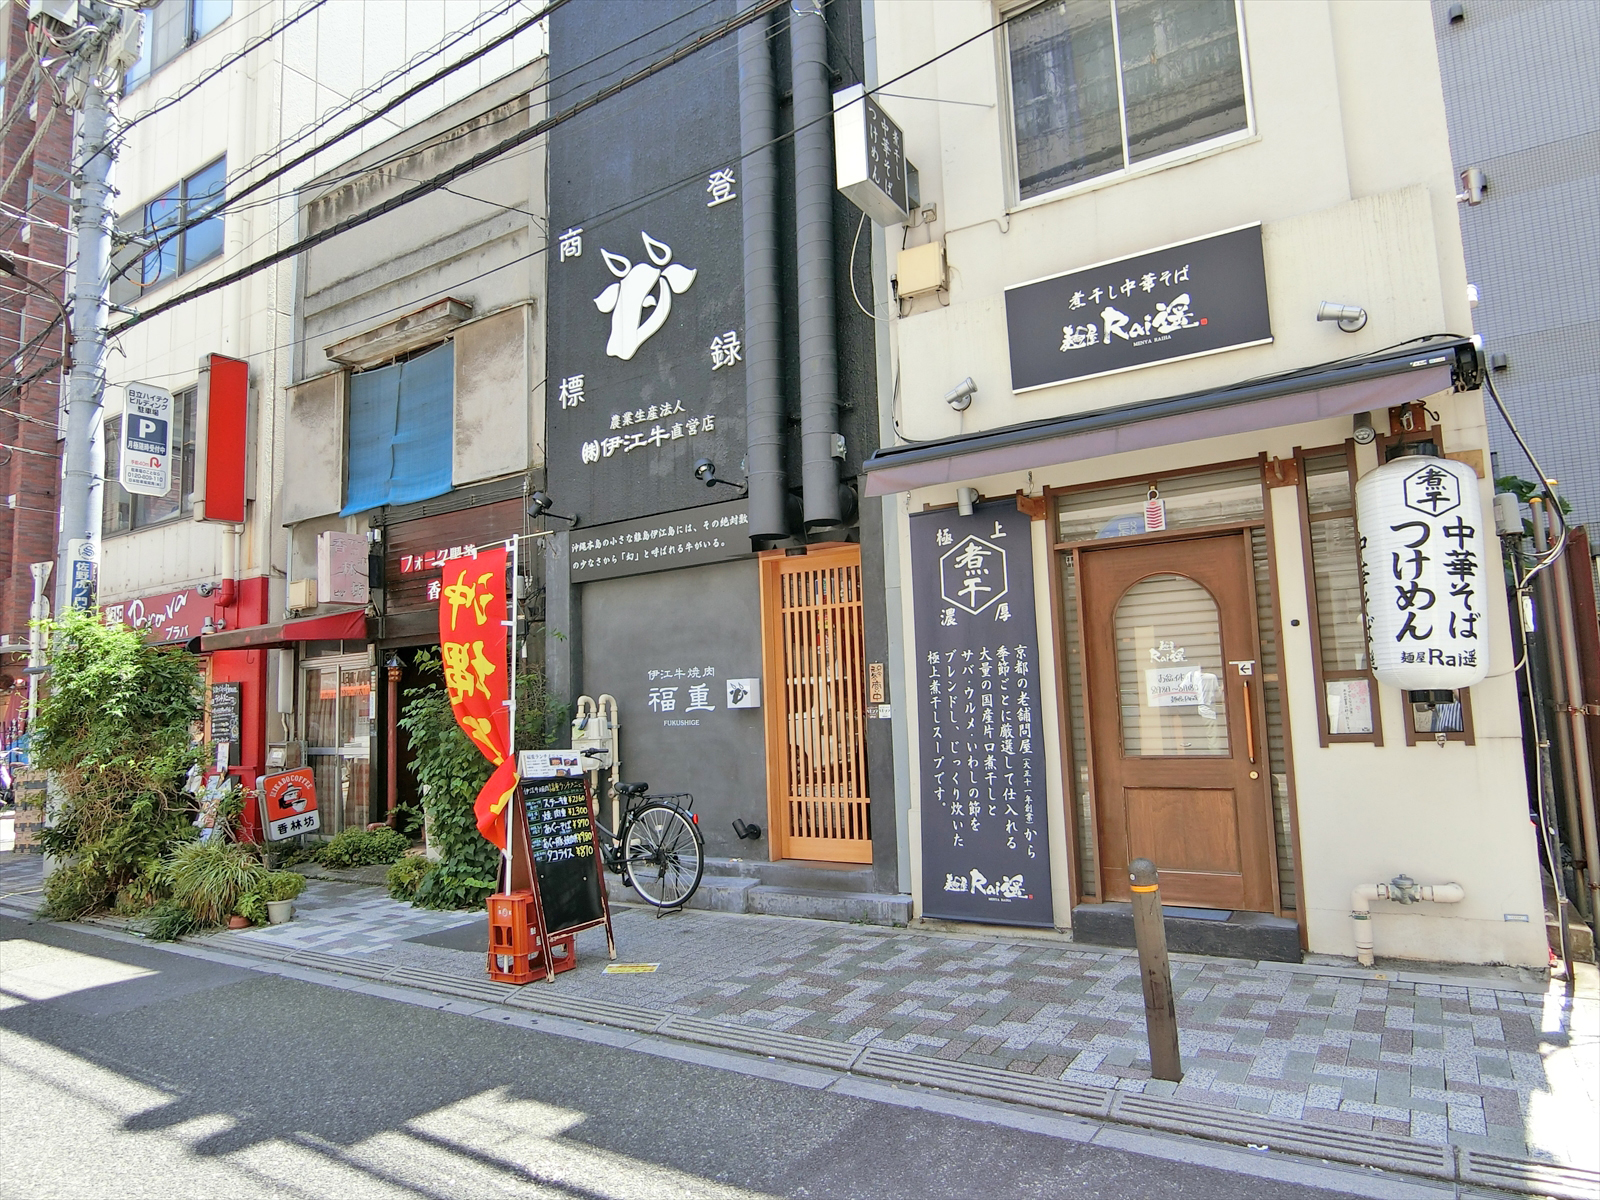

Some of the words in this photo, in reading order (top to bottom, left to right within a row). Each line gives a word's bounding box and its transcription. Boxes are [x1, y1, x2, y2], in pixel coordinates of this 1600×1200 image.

[868, 106, 880, 184] つけめん
[881, 118, 893, 198] 中華そば
[706, 167, 737, 208] 登
[558, 227, 584, 263] 商
[1068, 264, 1190, 310] 煮干し中華そば
[709, 330, 742, 370] 録
[129, 389, 169, 404] 日立ハイテク
[129, 397, 168, 411] ビルディング
[558, 373, 586, 410] 標
[138, 418, 156, 438] P
[609, 399, 686, 431] 農業生産法人
[1415, 466, 1451, 512] 煮干
[936, 528, 953, 546] 極
[990, 520, 1007, 539] 上
[954, 541, 992, 608] 煮干
[1390, 519, 1437, 643] つけめん
[1442, 516, 1482, 640] 中華そば
[940, 607, 958, 626] 濃
[994, 602, 1012, 622] 厚
[647, 665, 716, 681] 伊江牛焼肉
[647, 682, 716, 713] 福重
[663, 718, 700, 727] FUKUSHIGE
[978, 646, 998, 816] 大量の国産片口煮干しと
[944, 648, 965, 847] ブレンドし、じっくり炊いた
[995, 644, 1018, 850] 季節ごとに厳選して仕入れる
[277, 815, 315, 835] 香林坊
